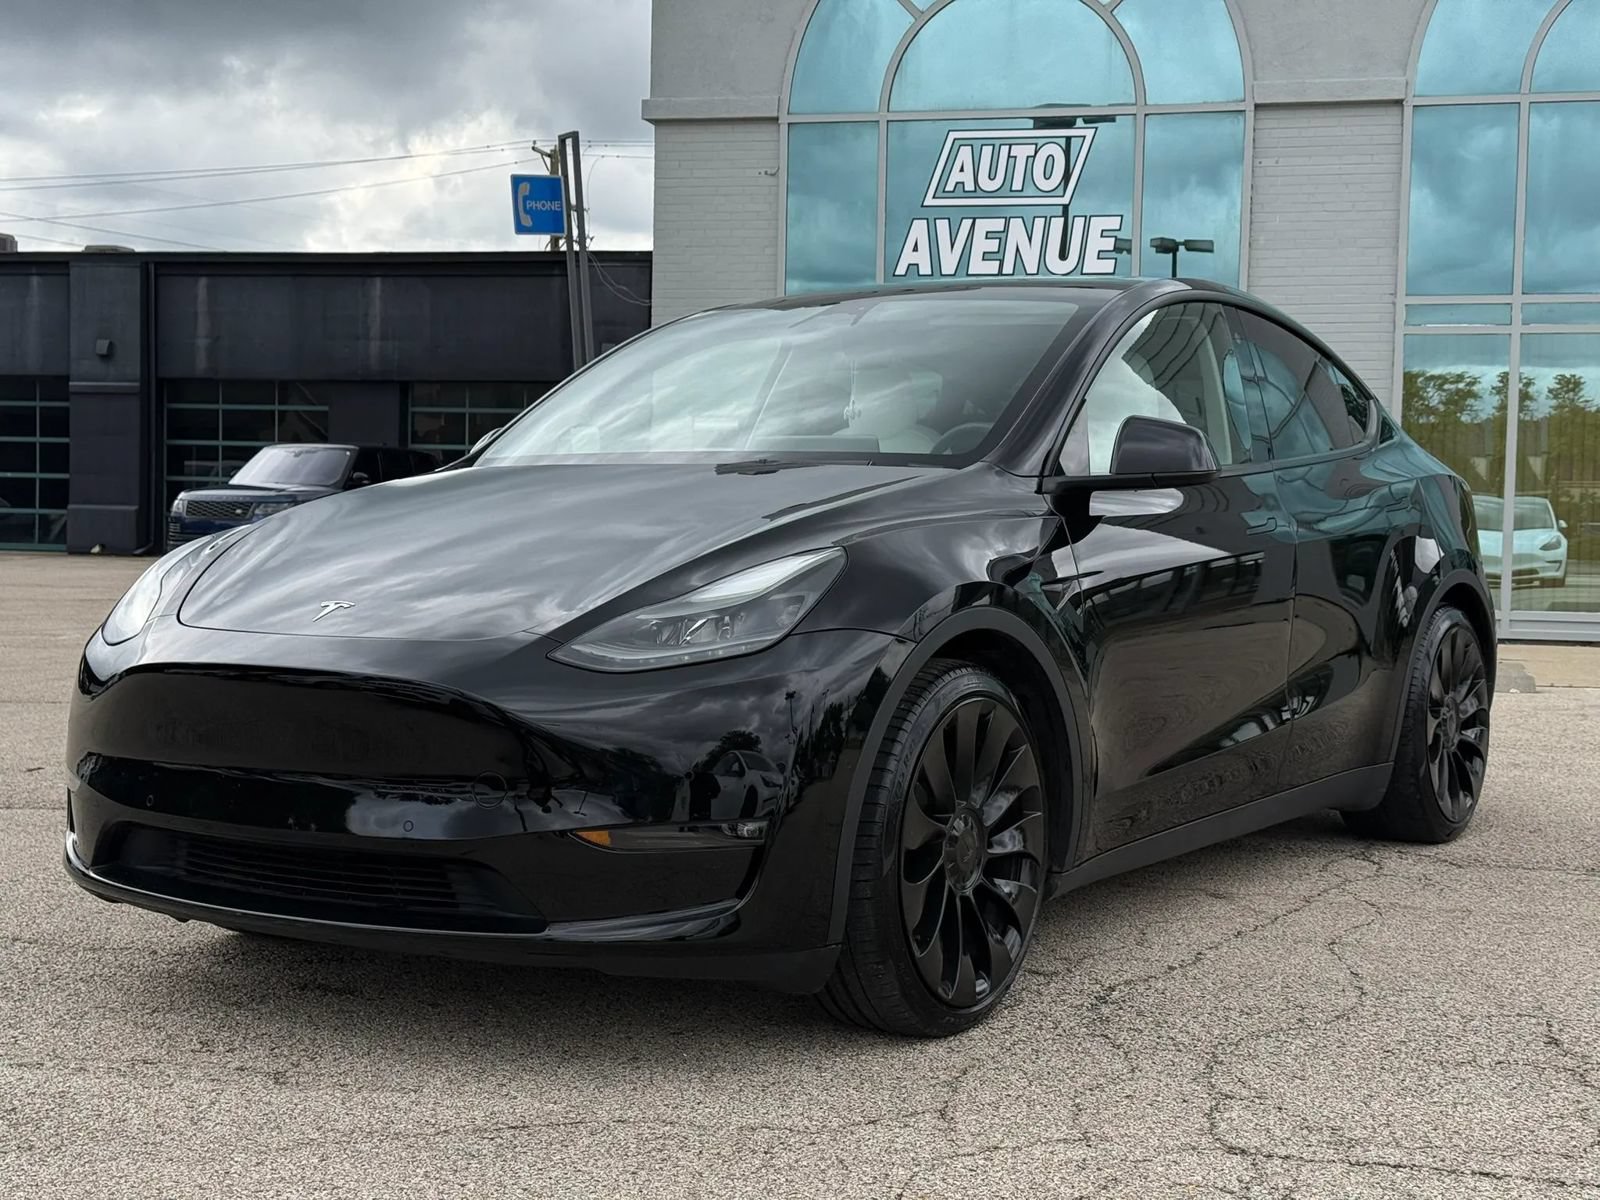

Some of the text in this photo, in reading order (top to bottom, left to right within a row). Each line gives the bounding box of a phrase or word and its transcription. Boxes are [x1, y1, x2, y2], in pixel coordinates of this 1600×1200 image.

[943, 142, 1067, 193] AUTO
[526, 200, 562, 212] PHONE
[893, 215, 1123, 277] AVENUE
